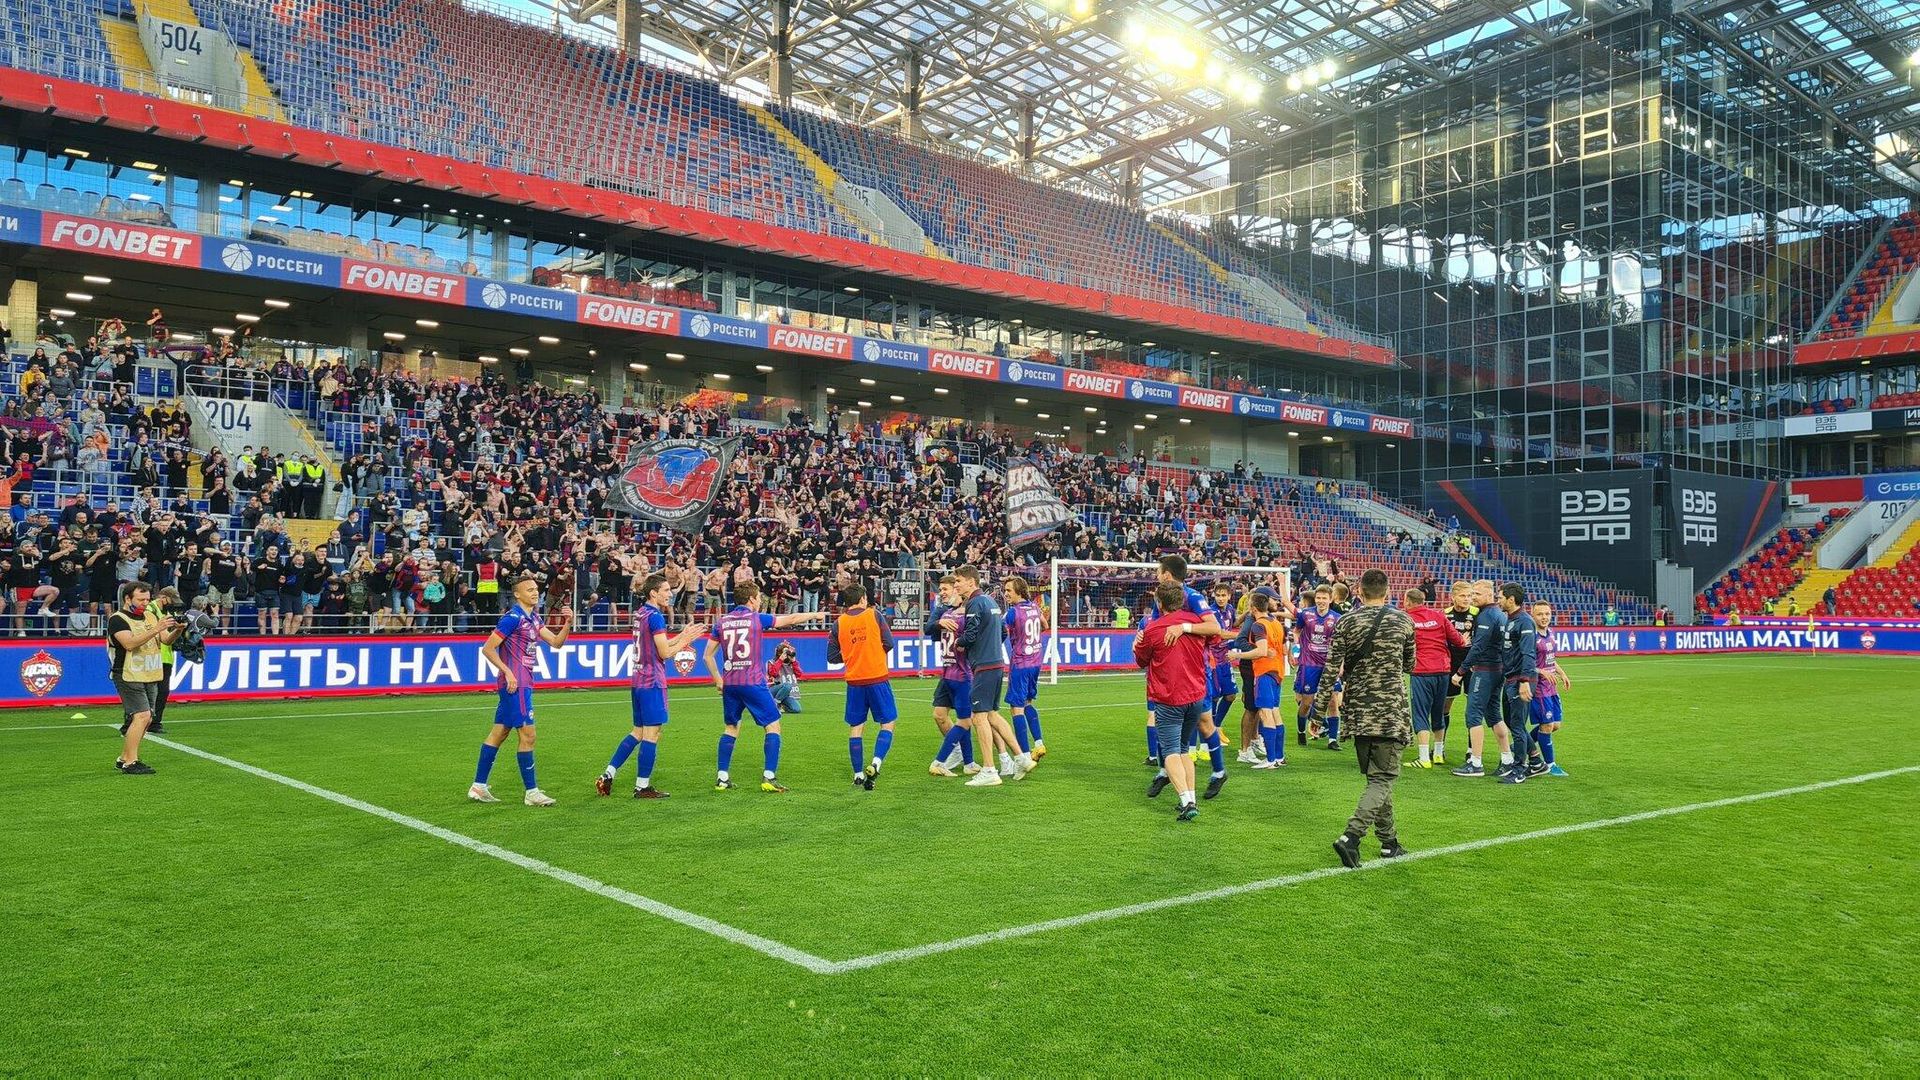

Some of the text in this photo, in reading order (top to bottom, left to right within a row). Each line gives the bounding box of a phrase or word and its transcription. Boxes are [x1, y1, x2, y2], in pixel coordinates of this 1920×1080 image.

[162, 23, 201, 55] 504
[52, 220, 192, 259] FONBET
[257, 254, 322, 277] РОССЕТИ
[347, 264, 458, 299] FONBET
[510, 293, 563, 311] РОССЕТИ
[584, 301, 674, 330] FONBET
[713, 323, 756, 339] РОССЕТИ
[773, 329, 848, 354] FONBET
[882, 348, 919, 362] РОССЕТИ
[932, 352, 995, 375] FONBET
[1024, 369, 1055, 382] РОССЕТИ
[1068, 372, 1121, 394] FONBET
[1145, 387, 1172, 399] РОССЕТИ
[1182, 390, 1230, 409] FONBET
[205, 400, 251, 431] 204
[1251, 402, 1275, 414] РОССЕТИ
[1282, 405, 1325, 422] FONBET
[1343, 416, 1364, 426] РОССЕТИ
[1372, 418, 1410, 434] FONBET
[1561, 488, 1631, 514] ВЭБ
[1682, 488, 1717, 514] ВЭБ
[1561, 523, 1631, 546] РФ
[1683, 523, 1717, 546] РФ
[1025, 617, 1040, 645] 90
[1574, 632, 1619, 651] МАТЧИ
[1676, 630, 1838, 649] БИЛЕТЫ НА МАТЧИ
[723, 628, 750, 659] 73
[1043, 637, 1111, 664] АТЧИ
[24, 663, 58, 677] ЦСКА
[170, 648, 369, 691] ИЛЕТЫ
[390, 647, 461, 684] НА
